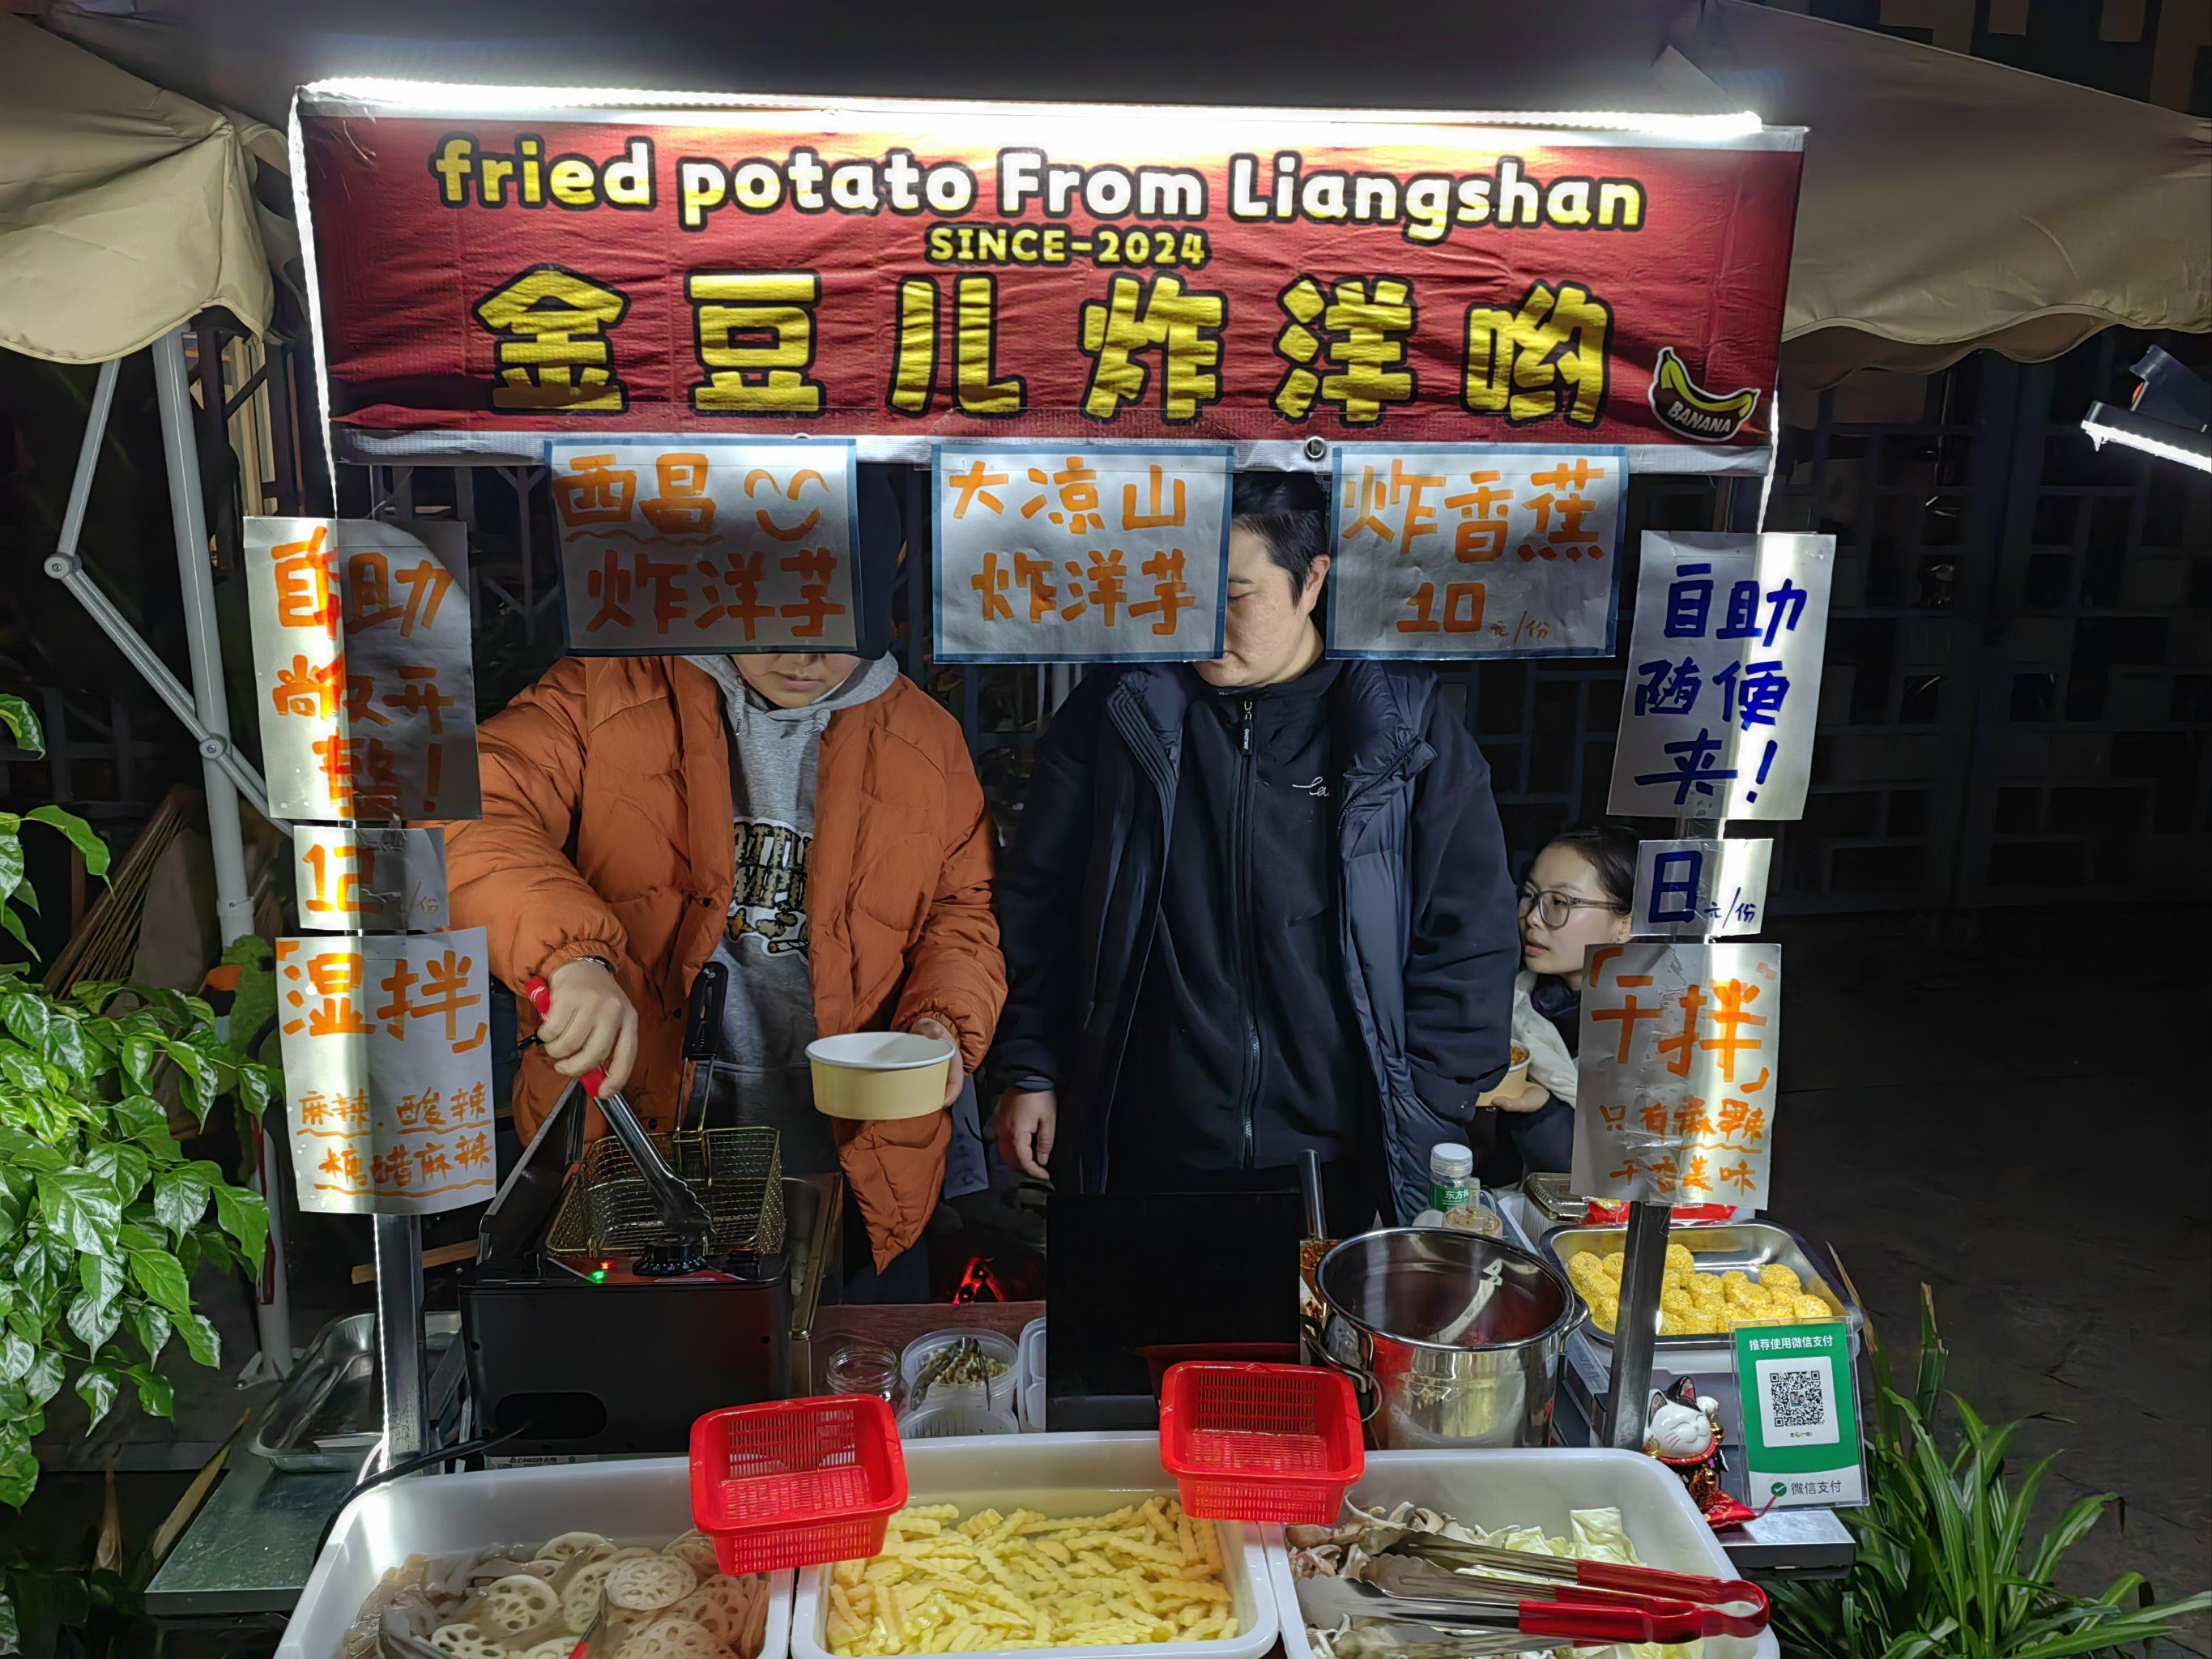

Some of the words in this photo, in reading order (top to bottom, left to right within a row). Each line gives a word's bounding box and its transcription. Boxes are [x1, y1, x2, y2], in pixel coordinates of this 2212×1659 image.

[435, 137, 653, 208] fried
[681, 148, 974, 229] potato
[1001, 151, 1205, 218] From
[1231, 155, 1643, 243] Liangshan
[928, 228, 1206, 267] SINCE-2024
[1666, 400, 1732, 433] BANANA
[552, 453, 717, 534] 西昌
[948, 455, 1186, 535] 大凉山
[1341, 458, 1605, 563] 炸香蕉
[271, 526, 454, 638] 自助
[586, 547, 846, 642] 炸洋芋
[971, 548, 1196, 636] 炸洋芋
[1663, 562, 1808, 647] 自助
[1634, 656, 1791, 731] 随便
[1749, 1335, 1833, 1351] 推荐使用微信支付
[1791, 1480, 1842, 1495] 微信支付
